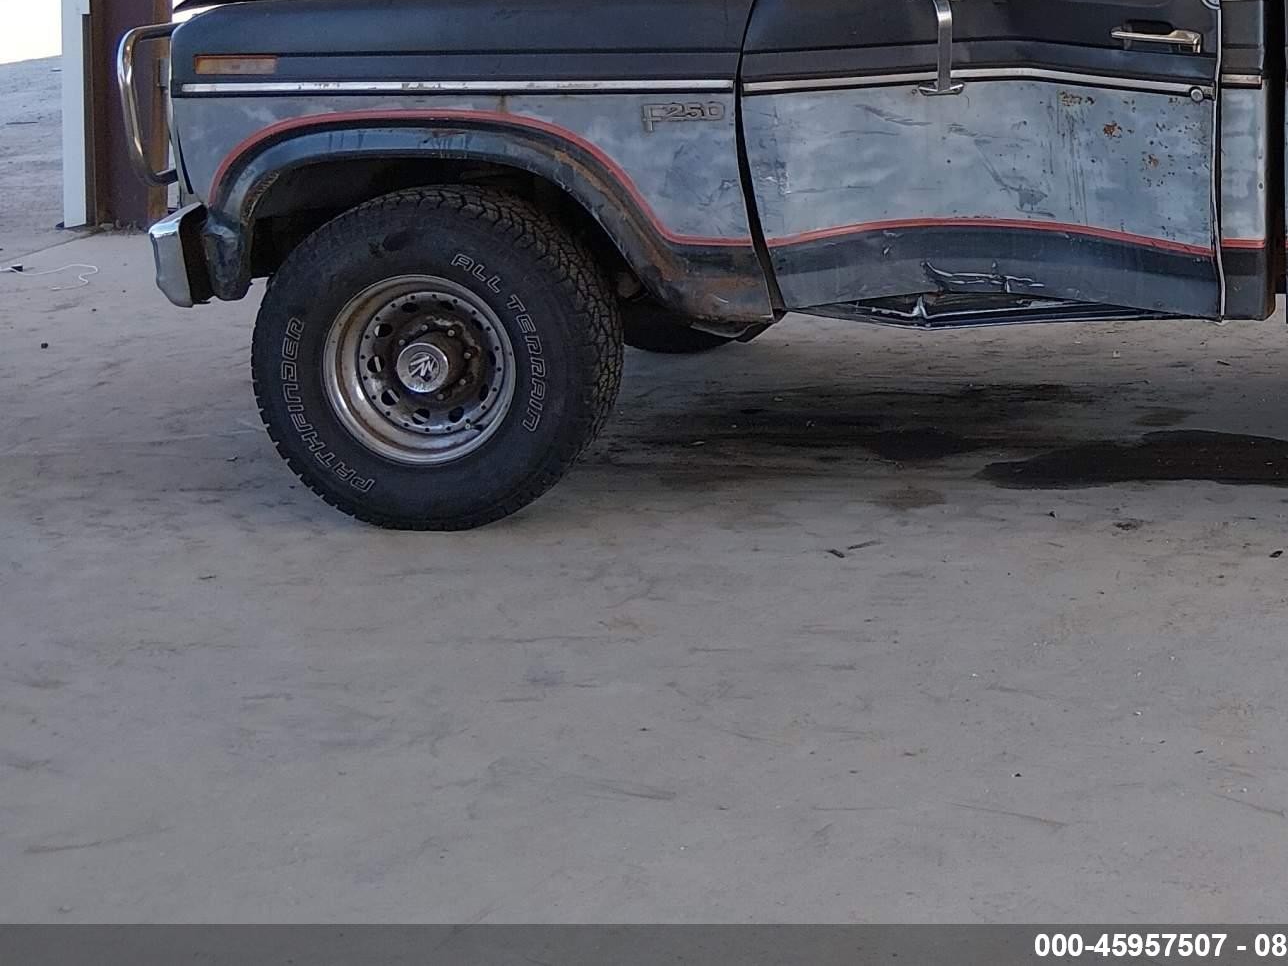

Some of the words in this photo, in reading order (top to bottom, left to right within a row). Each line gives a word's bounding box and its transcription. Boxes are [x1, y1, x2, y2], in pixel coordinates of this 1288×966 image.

[641, 100, 726, 133] F250
[281, 317, 377, 493] PATHFINDER
[451, 252, 501, 294] ALL
[508, 295, 548, 433] TERRAIN
